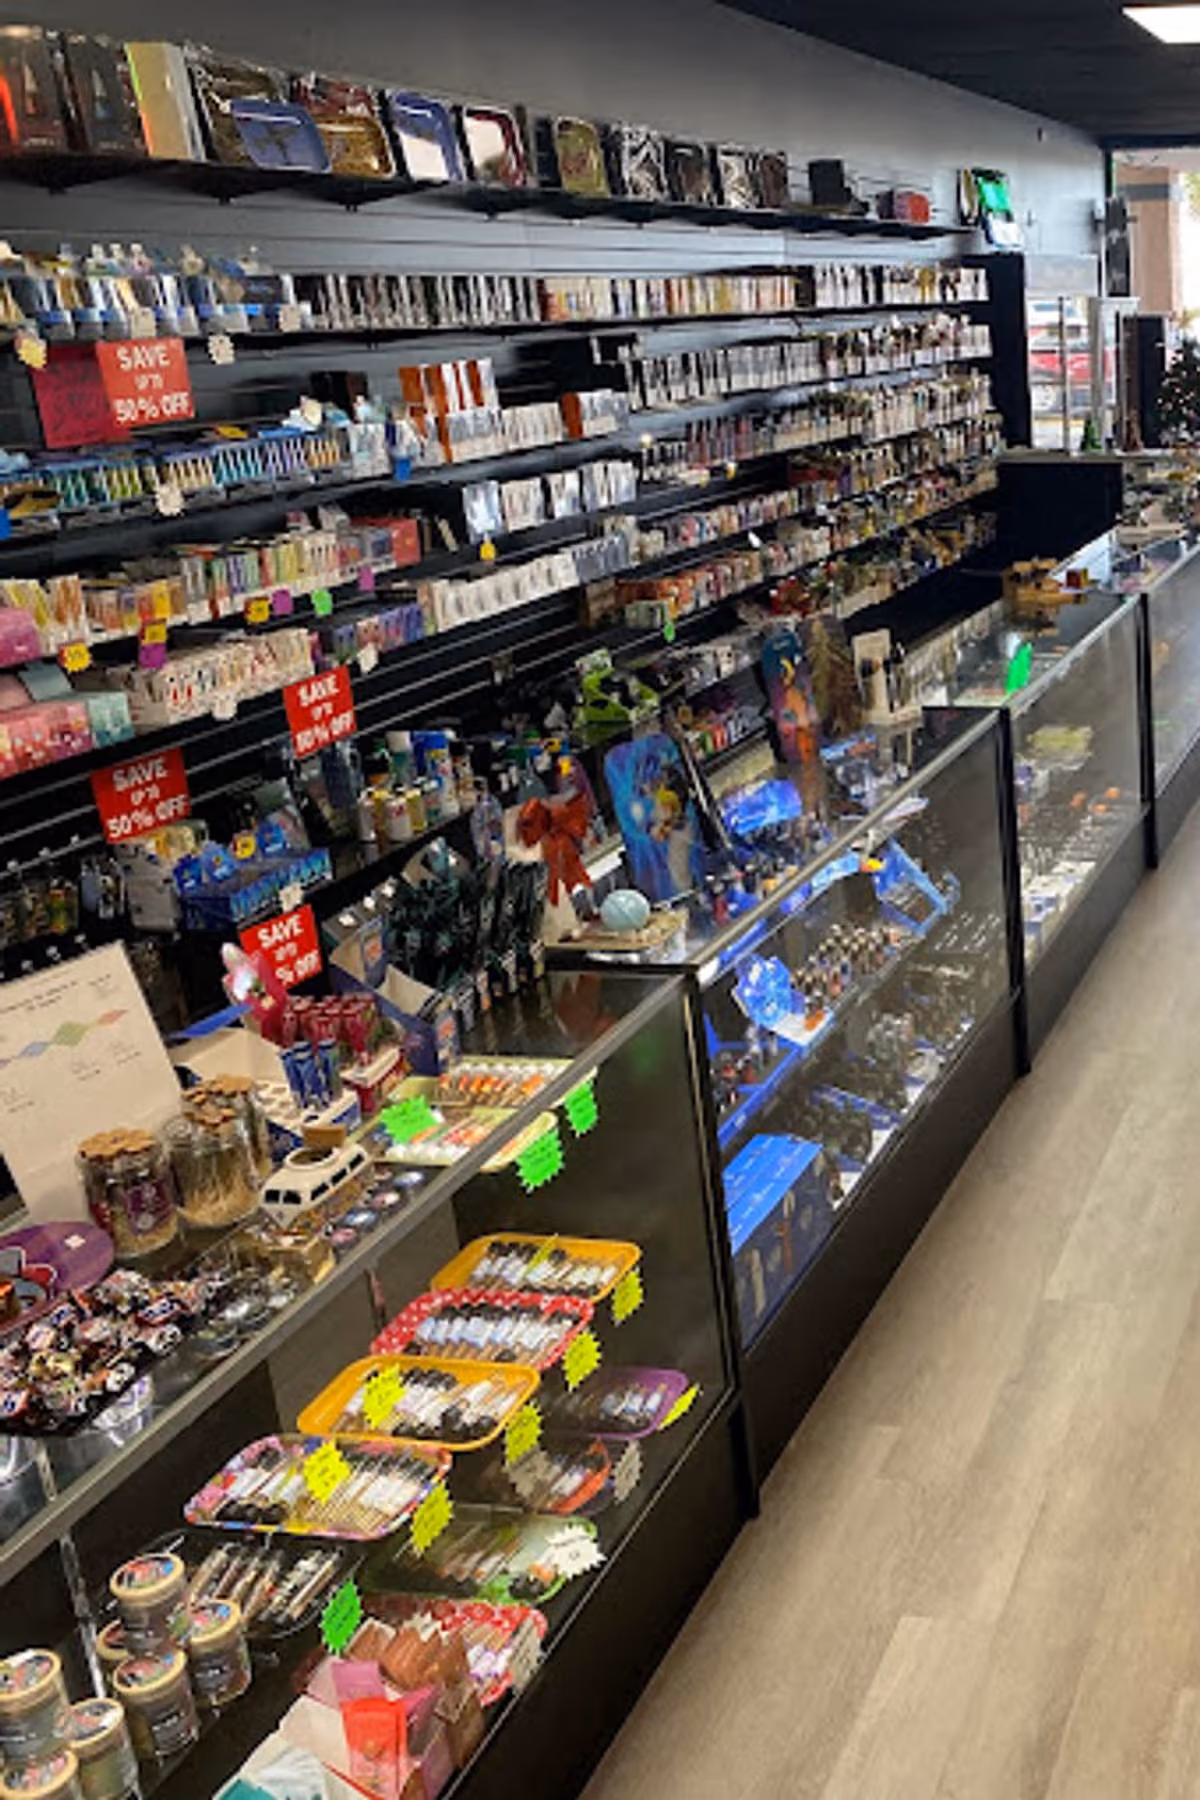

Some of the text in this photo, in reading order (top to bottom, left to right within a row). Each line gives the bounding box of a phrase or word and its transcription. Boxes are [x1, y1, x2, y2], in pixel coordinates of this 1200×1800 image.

[116, 343, 170, 371] SAVE
[113, 394, 159, 422] 50%
[112, 757, 168, 792] SAVE
[107, 807, 155, 838] 50%
[257, 913, 304, 949] SAVE
